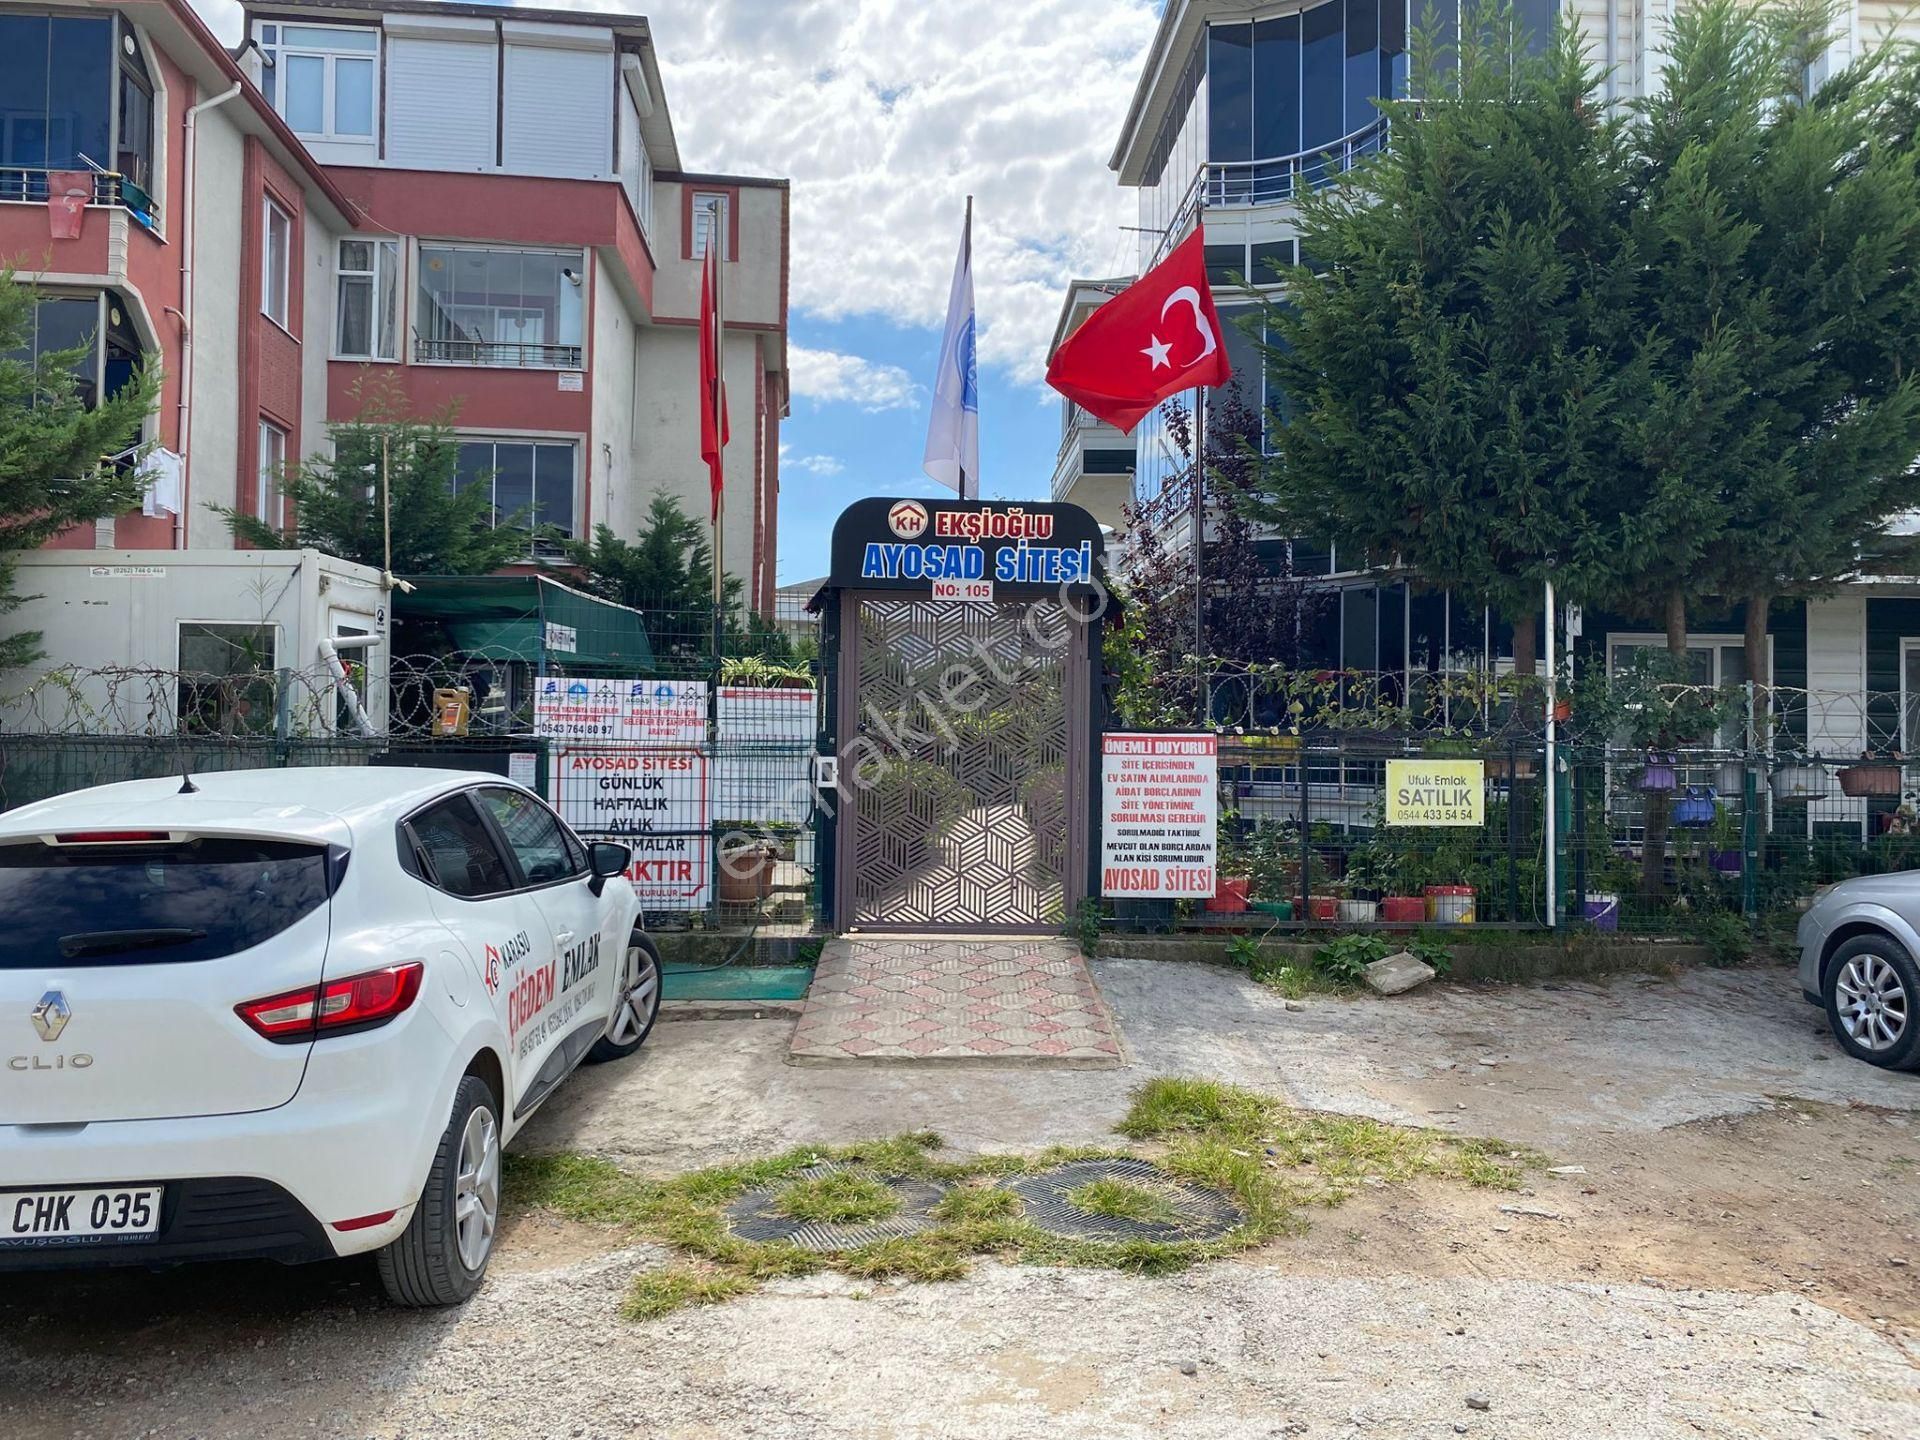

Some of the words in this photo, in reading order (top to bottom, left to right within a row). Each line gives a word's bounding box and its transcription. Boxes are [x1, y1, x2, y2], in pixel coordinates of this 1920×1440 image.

[896, 517, 921, 531] KH
[936, 507, 1054, 544] EKŞİOĞLU
[862, 543, 985, 580] AYOSAD
[996, 539, 1091, 584] SİTESİ
[935, 584, 960, 597] NO:
[965, 584, 990, 597] 105
[541, 724, 565, 733] 0543
[567, 725, 584, 733] 764
[587, 725, 599, 734] 80
[601, 725, 612, 734] 97
[1105, 738, 1152, 754] ÖNEMLİ
[1155, 741, 1206, 754] DUYURU
[572, 757, 639, 770] AYOSAD
[1121, 758, 1140, 770] SİTE
[1142, 758, 1195, 770] İÇERİSİNDEN
[600, 773, 664, 790] GÜNLÜK
[1107, 773, 1119, 783] EV
[1120, 773, 1147, 783] SATIN
[1149, 774, 1208, 783] ALIMLARINDA
[1408, 775, 1431, 786] Ufuk
[1435, 775, 1467, 786] Emlak
[1115, 787, 1141, 797] AİDAT
[1144, 787, 1201, 797] BORÇLARININ
[1398, 788, 1472, 806] SATILIK
[594, 797, 669, 811] HAFTALIK
[1121, 799, 1139, 810] SİTE
[1111, 812, 1165, 823] SORULMASI
[1167, 811, 1206, 823] GEREKİR
[1398, 809, 1420, 820] 0544
[1423, 809, 1442, 820] 433
[1445, 809, 1457, 820] 54
[1460, 809, 1472, 820] 54
[610, 818, 653, 831] AYLIK
[1167, 828, 1201, 837] TAKTİRDE
[1106, 843, 1137, 851] MEVCUT
[1139, 843, 1159, 851] OLAN
[1161, 843, 1211, 852] BORÇLARDAN
[1114, 854, 1134, 862] ALAN
[1136, 853, 1151, 863] KİŞİ
[1153, 854, 1204, 863] SORUMLUDUR
[1104, 867, 1160, 891] AYOSAD
[1165, 865, 1212, 891] SİTESİ
[500, 930, 530, 970] KARASU
[508, 960, 556, 1054] ÇİĞDEM
[562, 932, 600, 993] EMLAK
[7, 1053, 94, 1071] CLIO
[12, 1195, 75, 1233] CHK
[90, 1192, 151, 1230] 035
[0, 1236, 102, 1247] AVUŞOĞLU
